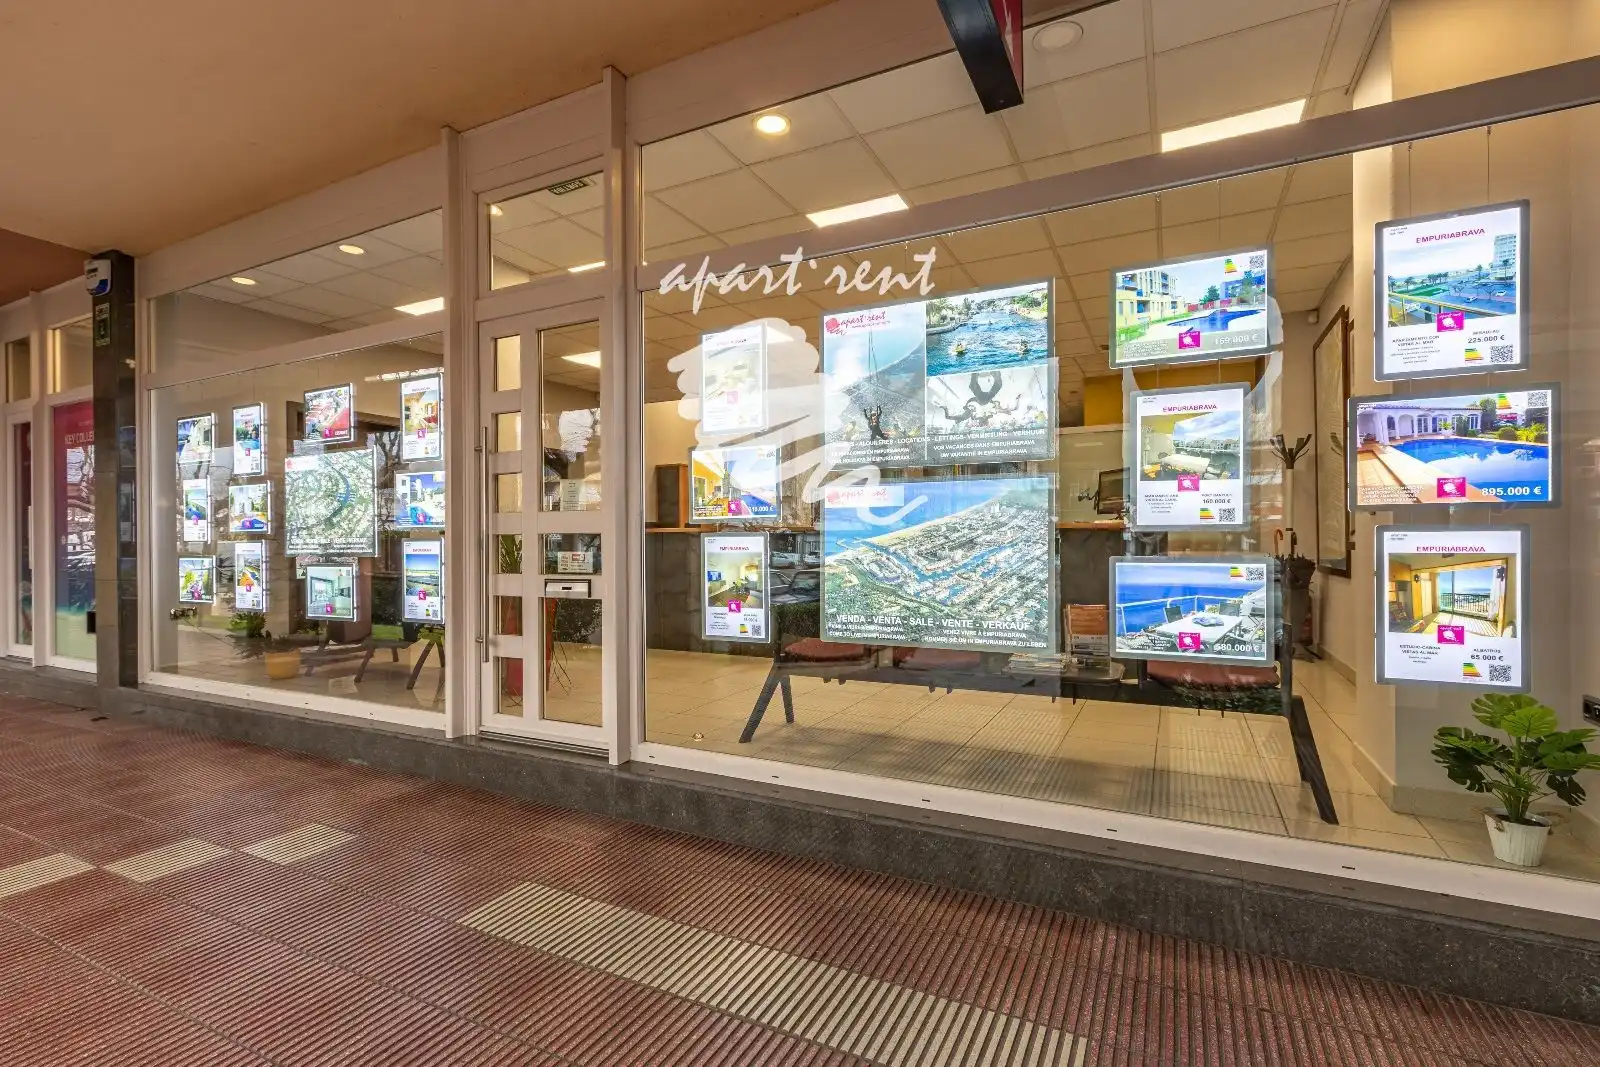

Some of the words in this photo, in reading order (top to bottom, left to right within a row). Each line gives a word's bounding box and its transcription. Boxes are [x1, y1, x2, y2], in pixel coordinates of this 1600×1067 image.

[1415, 227, 1486, 244] EMPURIABRAVA
[1467, 336, 1498, 344] 225.000
[1163, 404, 1218, 413] EMPURIABRAVA
[898, 436, 931, 444] LOCATIONS
[935, 434, 963, 442] LETTINGS
[1481, 486, 1530, 497] 895.000
[1532, 485, 1543, 495] €
[836, 614, 866, 623] VENDA
[872, 615, 903, 625] VENTA
[909, 617, 934, 627] SALE
[942, 618, 974, 628] VENTE
[981, 620, 1031, 631] VERKAUF
